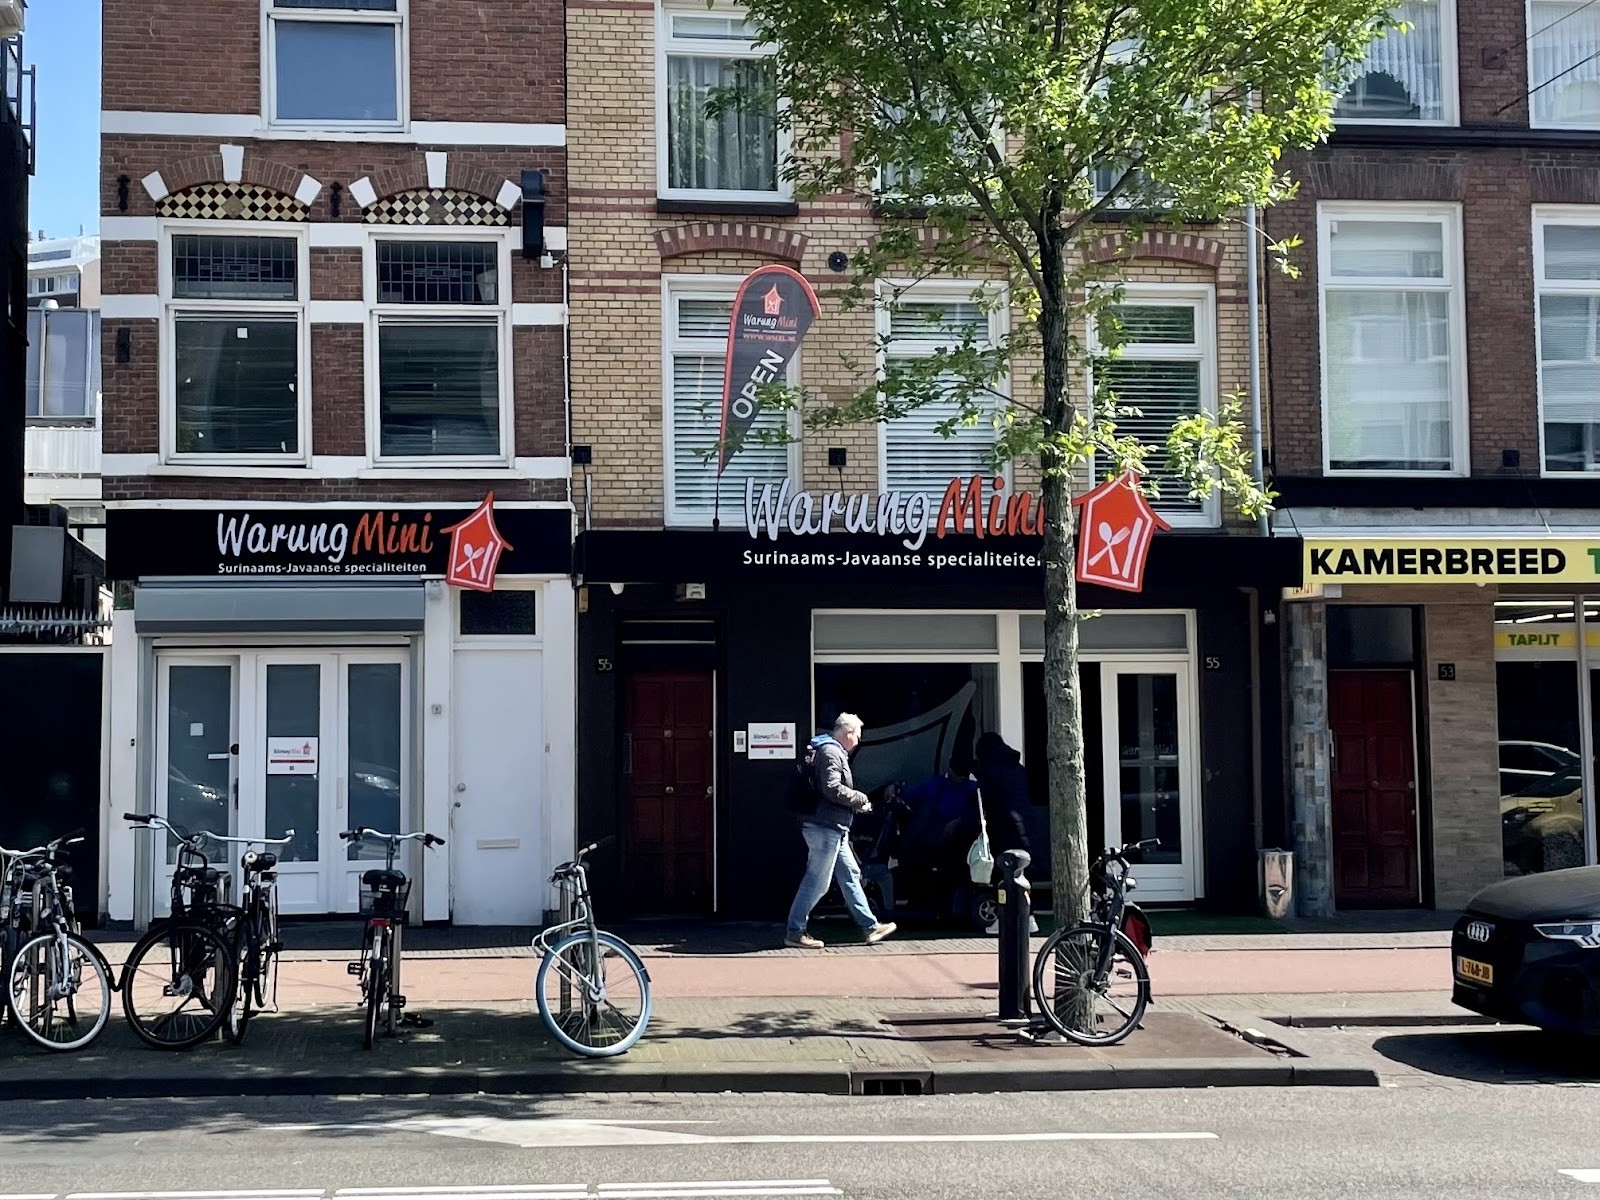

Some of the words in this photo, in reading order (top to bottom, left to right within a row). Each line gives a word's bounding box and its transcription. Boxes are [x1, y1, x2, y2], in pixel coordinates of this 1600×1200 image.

[743, 313, 777, 329] Warung
[777, 316, 798, 328] Mini
[732, 349, 784, 418] OPEN
[745, 476, 931, 551] Warung
[217, 513, 348, 563] Warung
[352, 511, 433, 555] Mini
[743, 550, 921, 566] Surinaams-Javaanse
[1310, 548, 1566, 575] KAMERBREED
[218, 563, 340, 574] Surinaams-Javaanse
[345, 562, 427, 576] specialiteiten
[1508, 634, 1560, 646] TAPIJT
[598, 658, 613, 671] 55
[1206, 656, 1220, 669] 55
[1440, 665, 1454, 678] 53
